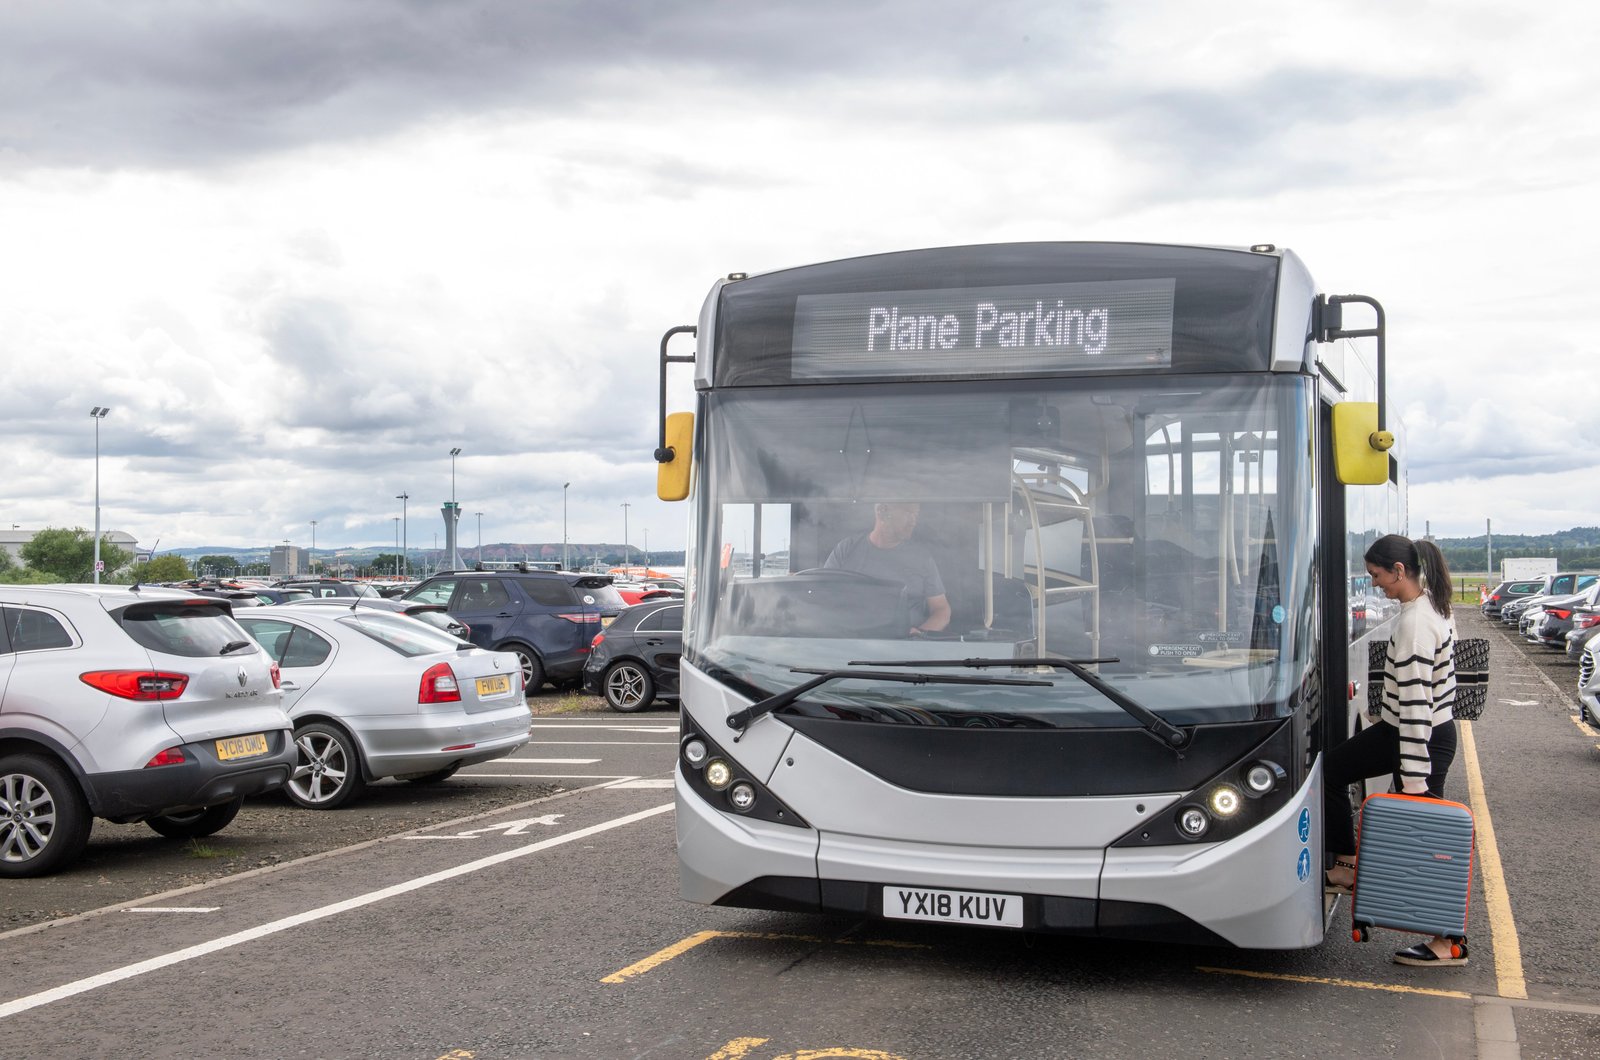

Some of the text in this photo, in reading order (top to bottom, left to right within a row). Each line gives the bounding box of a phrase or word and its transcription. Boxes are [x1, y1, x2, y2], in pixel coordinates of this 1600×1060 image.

[867, 299, 1109, 355] Plane Parking
[222, 738, 245, 756] YC18
[898, 891, 1006, 921] YX18 KUV
